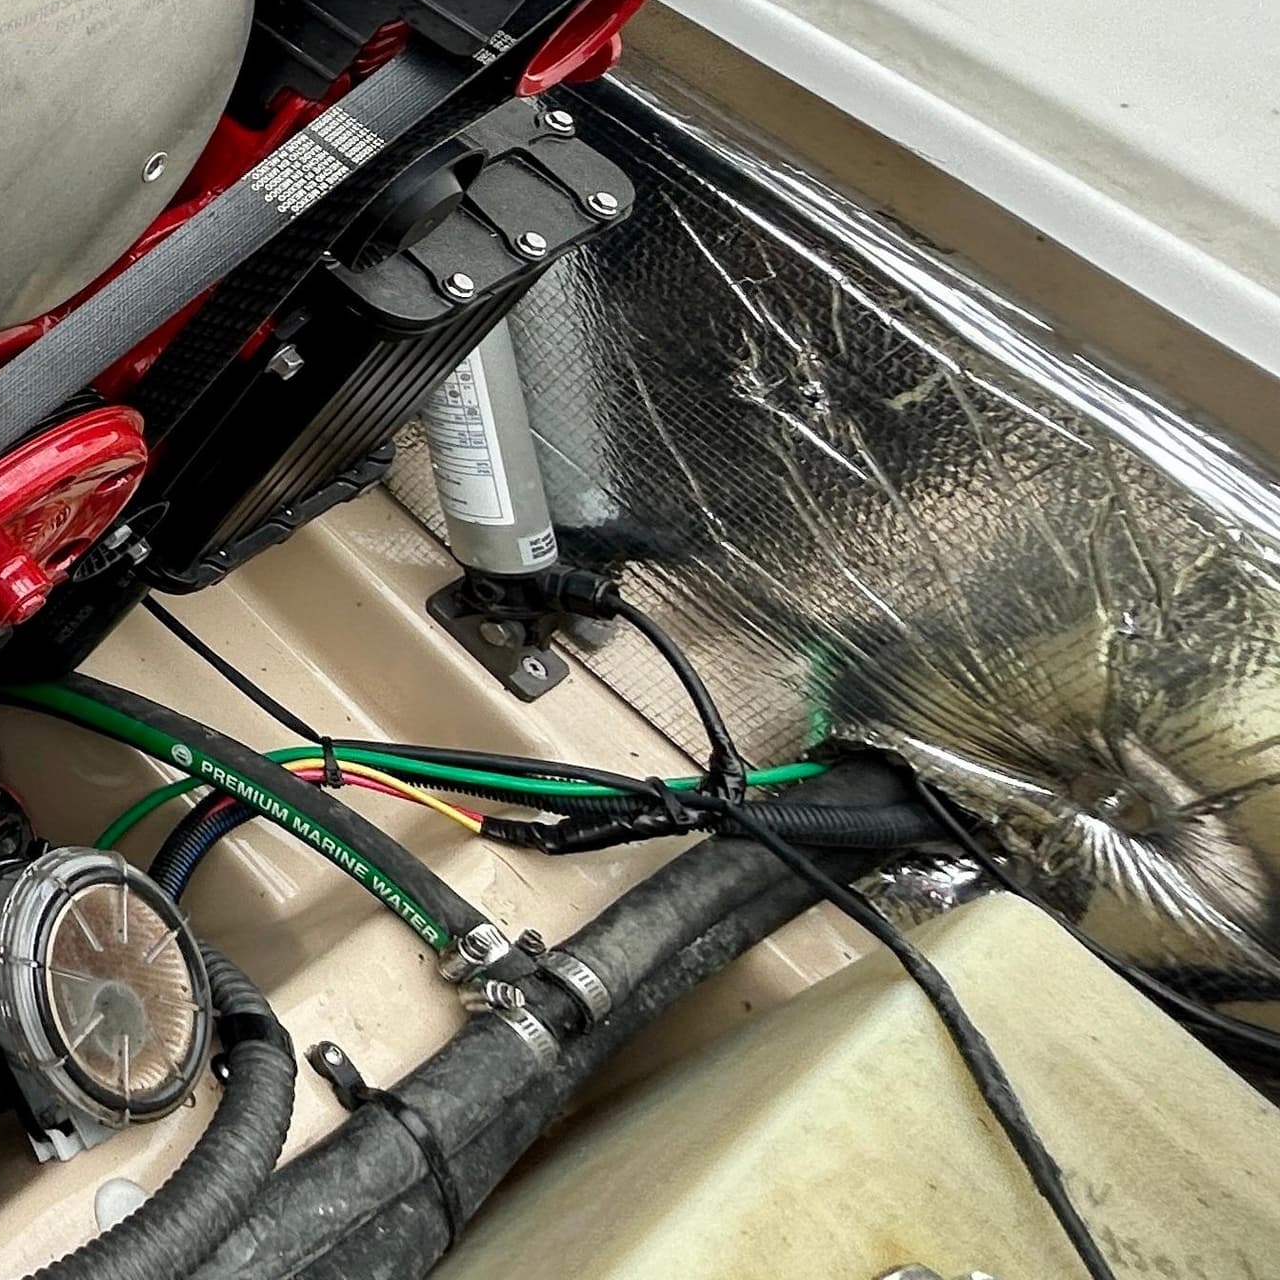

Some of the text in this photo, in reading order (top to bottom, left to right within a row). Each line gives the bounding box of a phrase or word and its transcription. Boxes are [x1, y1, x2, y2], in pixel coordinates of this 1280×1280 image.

[201, 759, 440, 945] PREMIUM MARINE WATER
